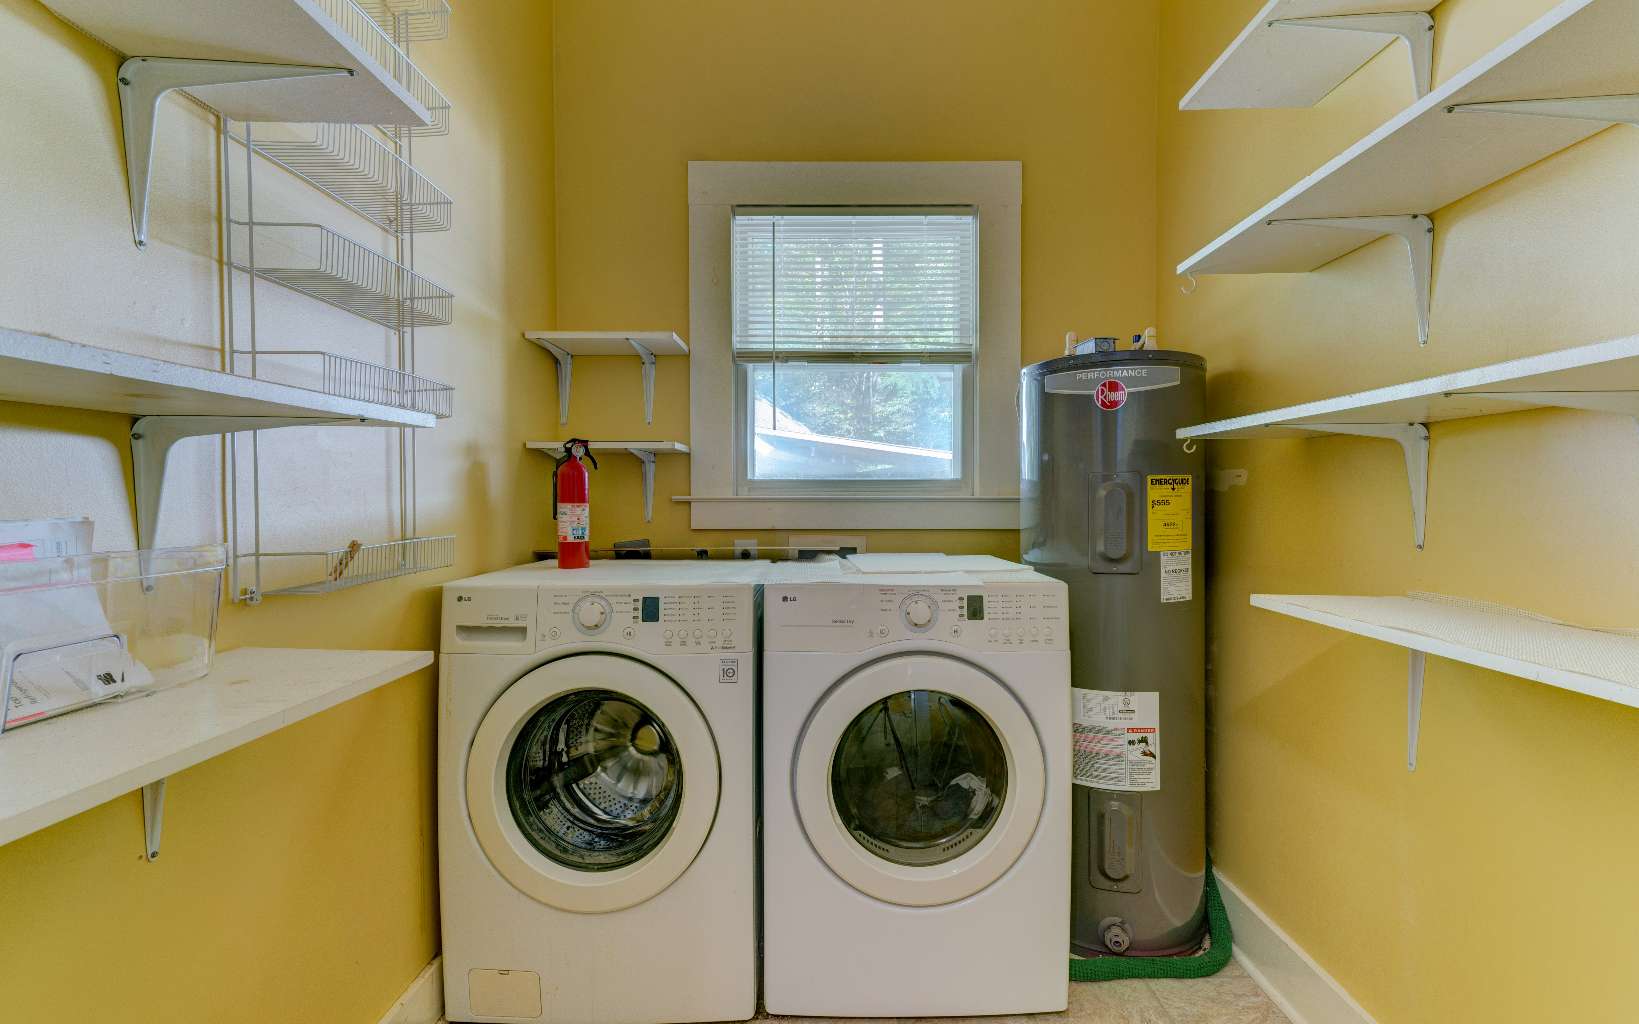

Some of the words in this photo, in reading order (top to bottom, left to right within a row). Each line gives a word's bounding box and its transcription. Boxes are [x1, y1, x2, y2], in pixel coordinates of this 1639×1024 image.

[1076, 369, 1148, 380] PERFORMANCE
[1098, 381, 1125, 405] Rheem
[1150, 477, 1190, 487] ENERGYGUIDE
